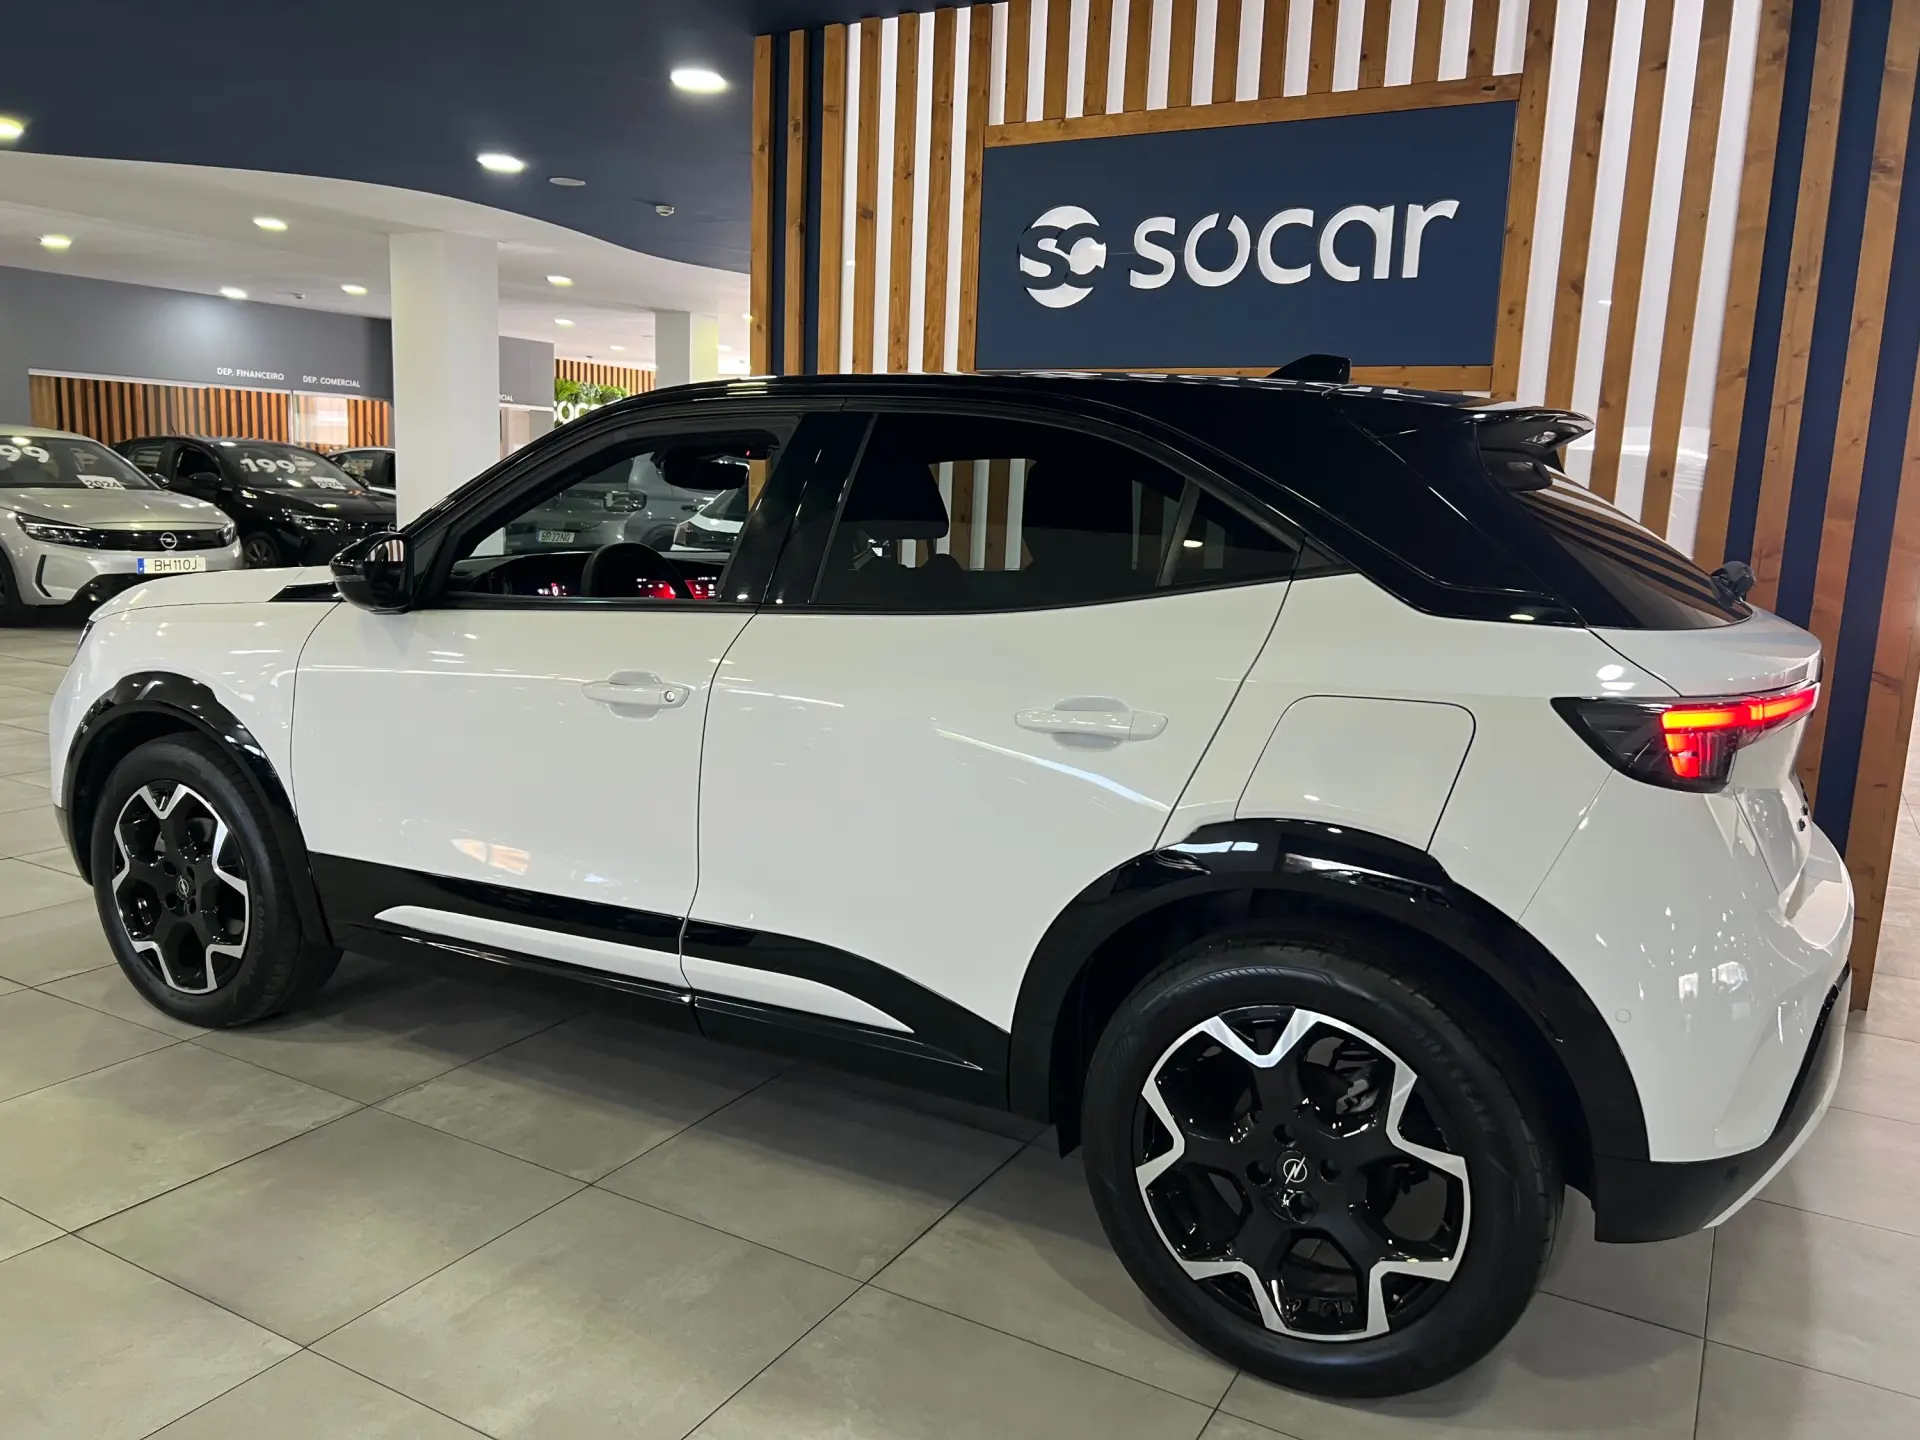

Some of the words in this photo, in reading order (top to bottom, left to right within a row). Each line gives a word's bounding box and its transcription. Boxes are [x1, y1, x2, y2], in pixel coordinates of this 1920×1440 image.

[1129, 199, 1460, 290] socar
[216, 366, 235, 377] DEP.
[236, 368, 285, 381] FINANCEIRO
[302, 374, 318, 384] DEP.
[319, 376, 361, 388] COMERCIAL
[240, 458, 296, 474] 199
